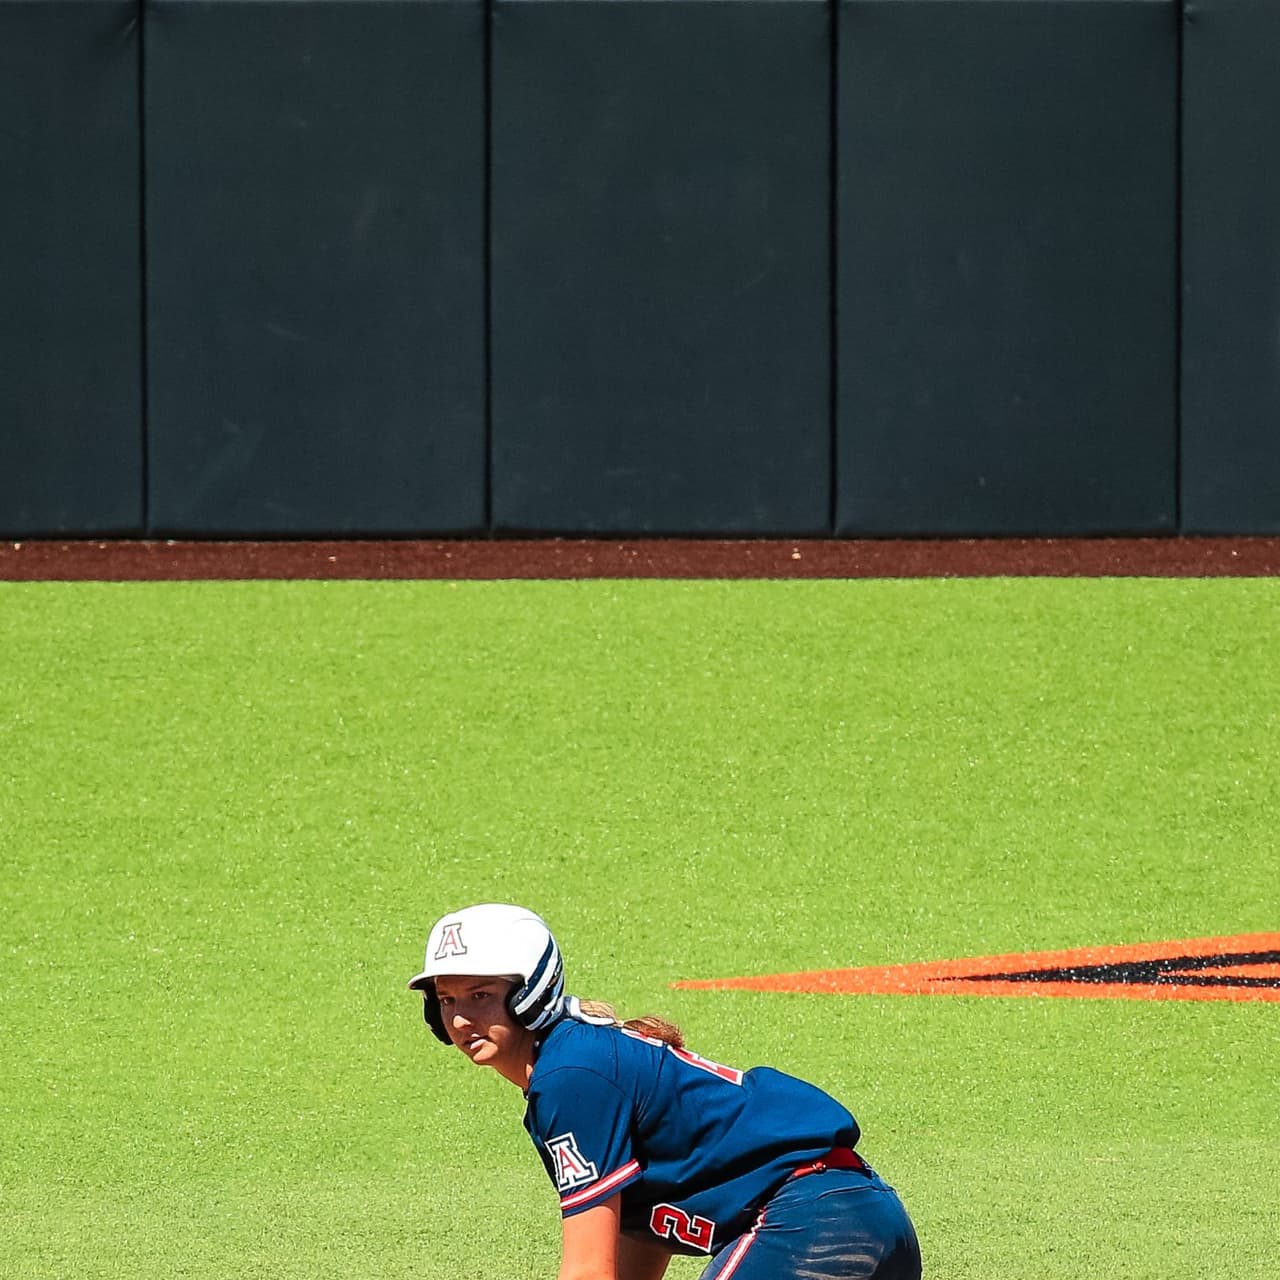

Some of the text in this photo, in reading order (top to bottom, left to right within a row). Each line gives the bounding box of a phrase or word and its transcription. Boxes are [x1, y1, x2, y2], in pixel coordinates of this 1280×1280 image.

[434, 922, 468, 961] A
[544, 1131, 600, 1193] A
[649, 1202, 716, 1254] 2
